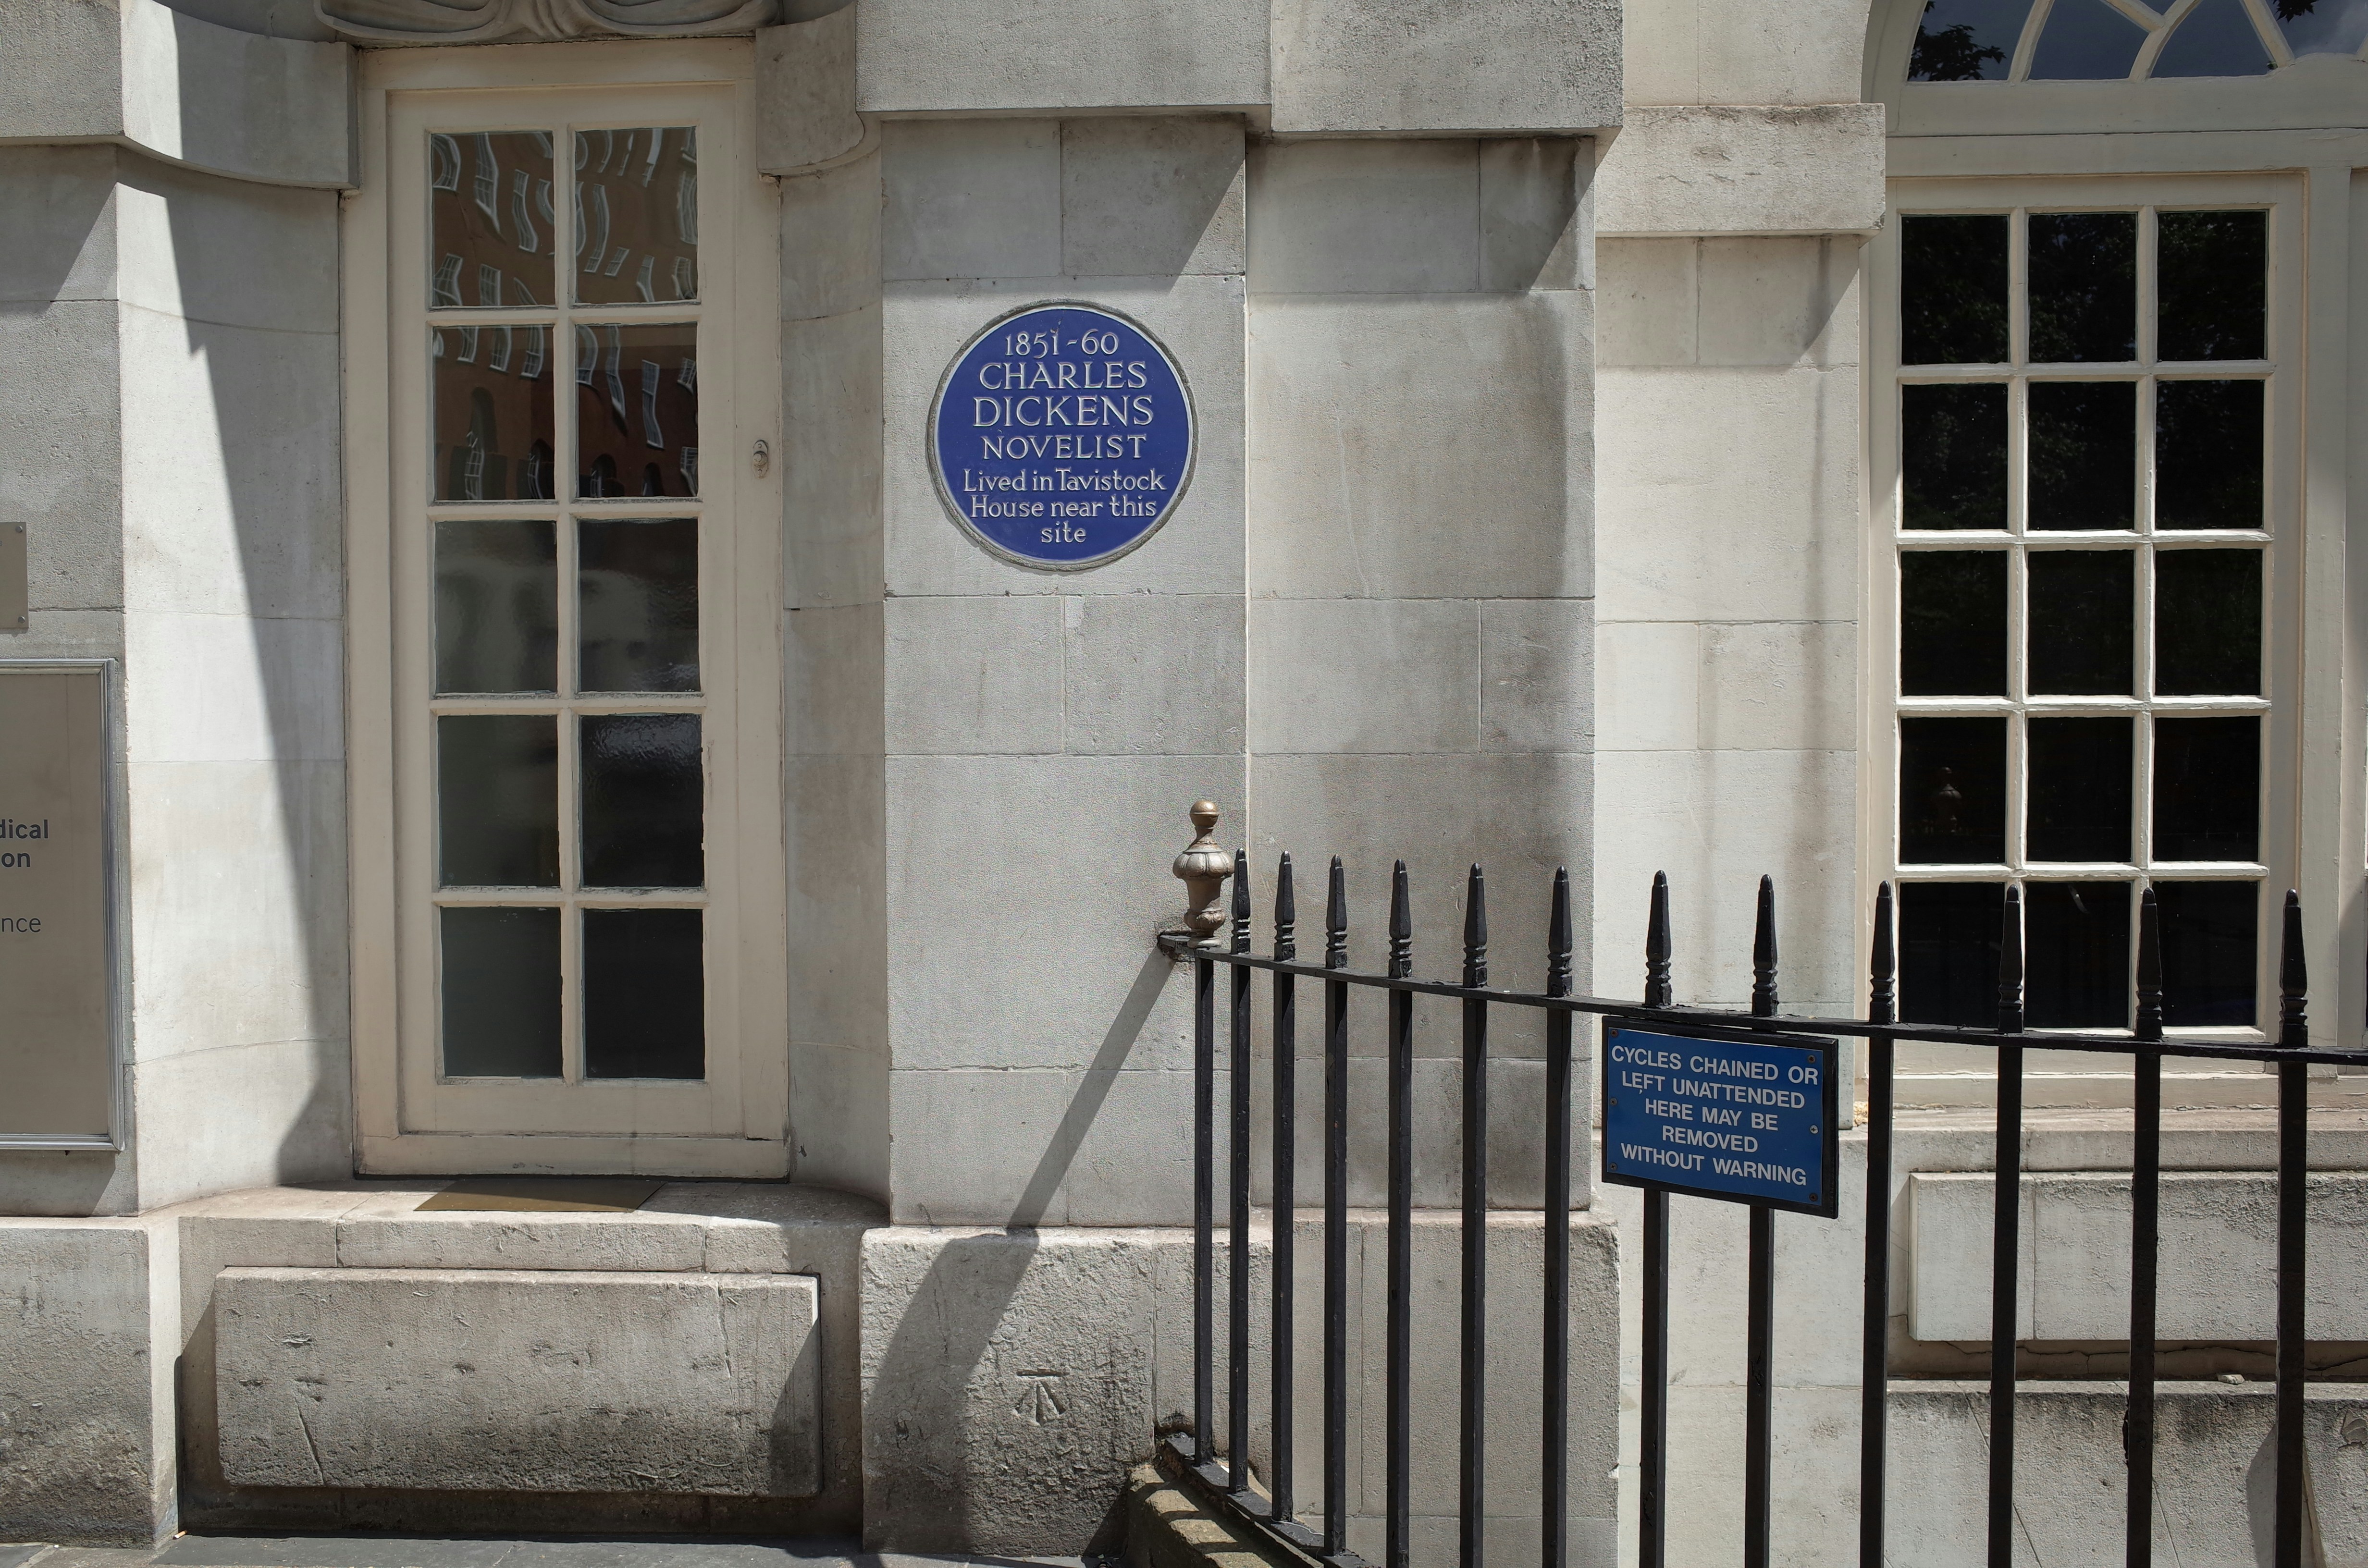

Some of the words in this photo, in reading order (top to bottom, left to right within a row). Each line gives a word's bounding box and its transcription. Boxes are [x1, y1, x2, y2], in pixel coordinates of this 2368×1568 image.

[979, 361, 1147, 390] CHARLES
[973, 394, 1154, 427] DICKENS
[981, 434, 1147, 459] NOVELIST
[963, 468, 1027, 491] Lived
[1032, 470, 1054, 491] in
[1055, 466, 1167, 491] Tavistock
[970, 494, 1044, 517] House
[1050, 502, 1103, 517] near
[1109, 494, 1157, 516] this
[1041, 520, 1086, 543] site
[1612, 1045, 1681, 1070] CYCLES
[1690, 1055, 1778, 1080] CHAINED
[1788, 1066, 1818, 1085] OR
[1622, 1071, 1665, 1092] LEFT
[1672, 1078, 1805, 1109] UNATTENDED
[1645, 1098, 1693, 1121] HERE
[1702, 1106, 1742, 1127] MAY
[1751, 1112, 1778, 1131] BE
[1662, 1125, 1759, 1153] REMOVED
[1620, 1141, 1705, 1171] WITHOUT
[1712, 1157, 1806, 1186] WARNING
